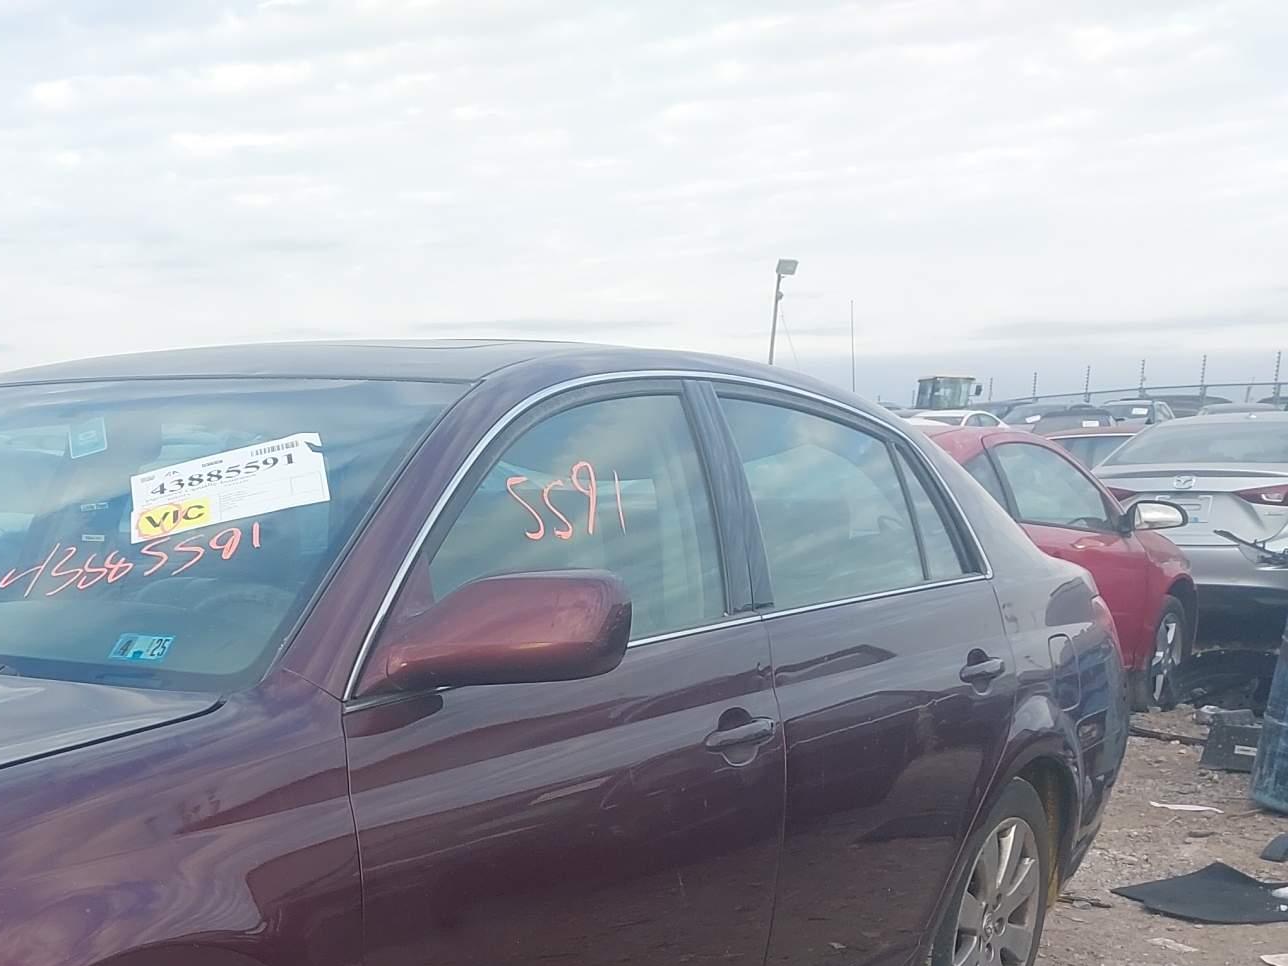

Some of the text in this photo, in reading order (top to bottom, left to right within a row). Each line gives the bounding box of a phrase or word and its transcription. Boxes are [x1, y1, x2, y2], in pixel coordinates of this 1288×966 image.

[150, 452, 294, 495] 43885591
[145, 505, 205, 529] VIC
[506, 461, 627, 540] 5591
[150, 638, 170, 657] 25
